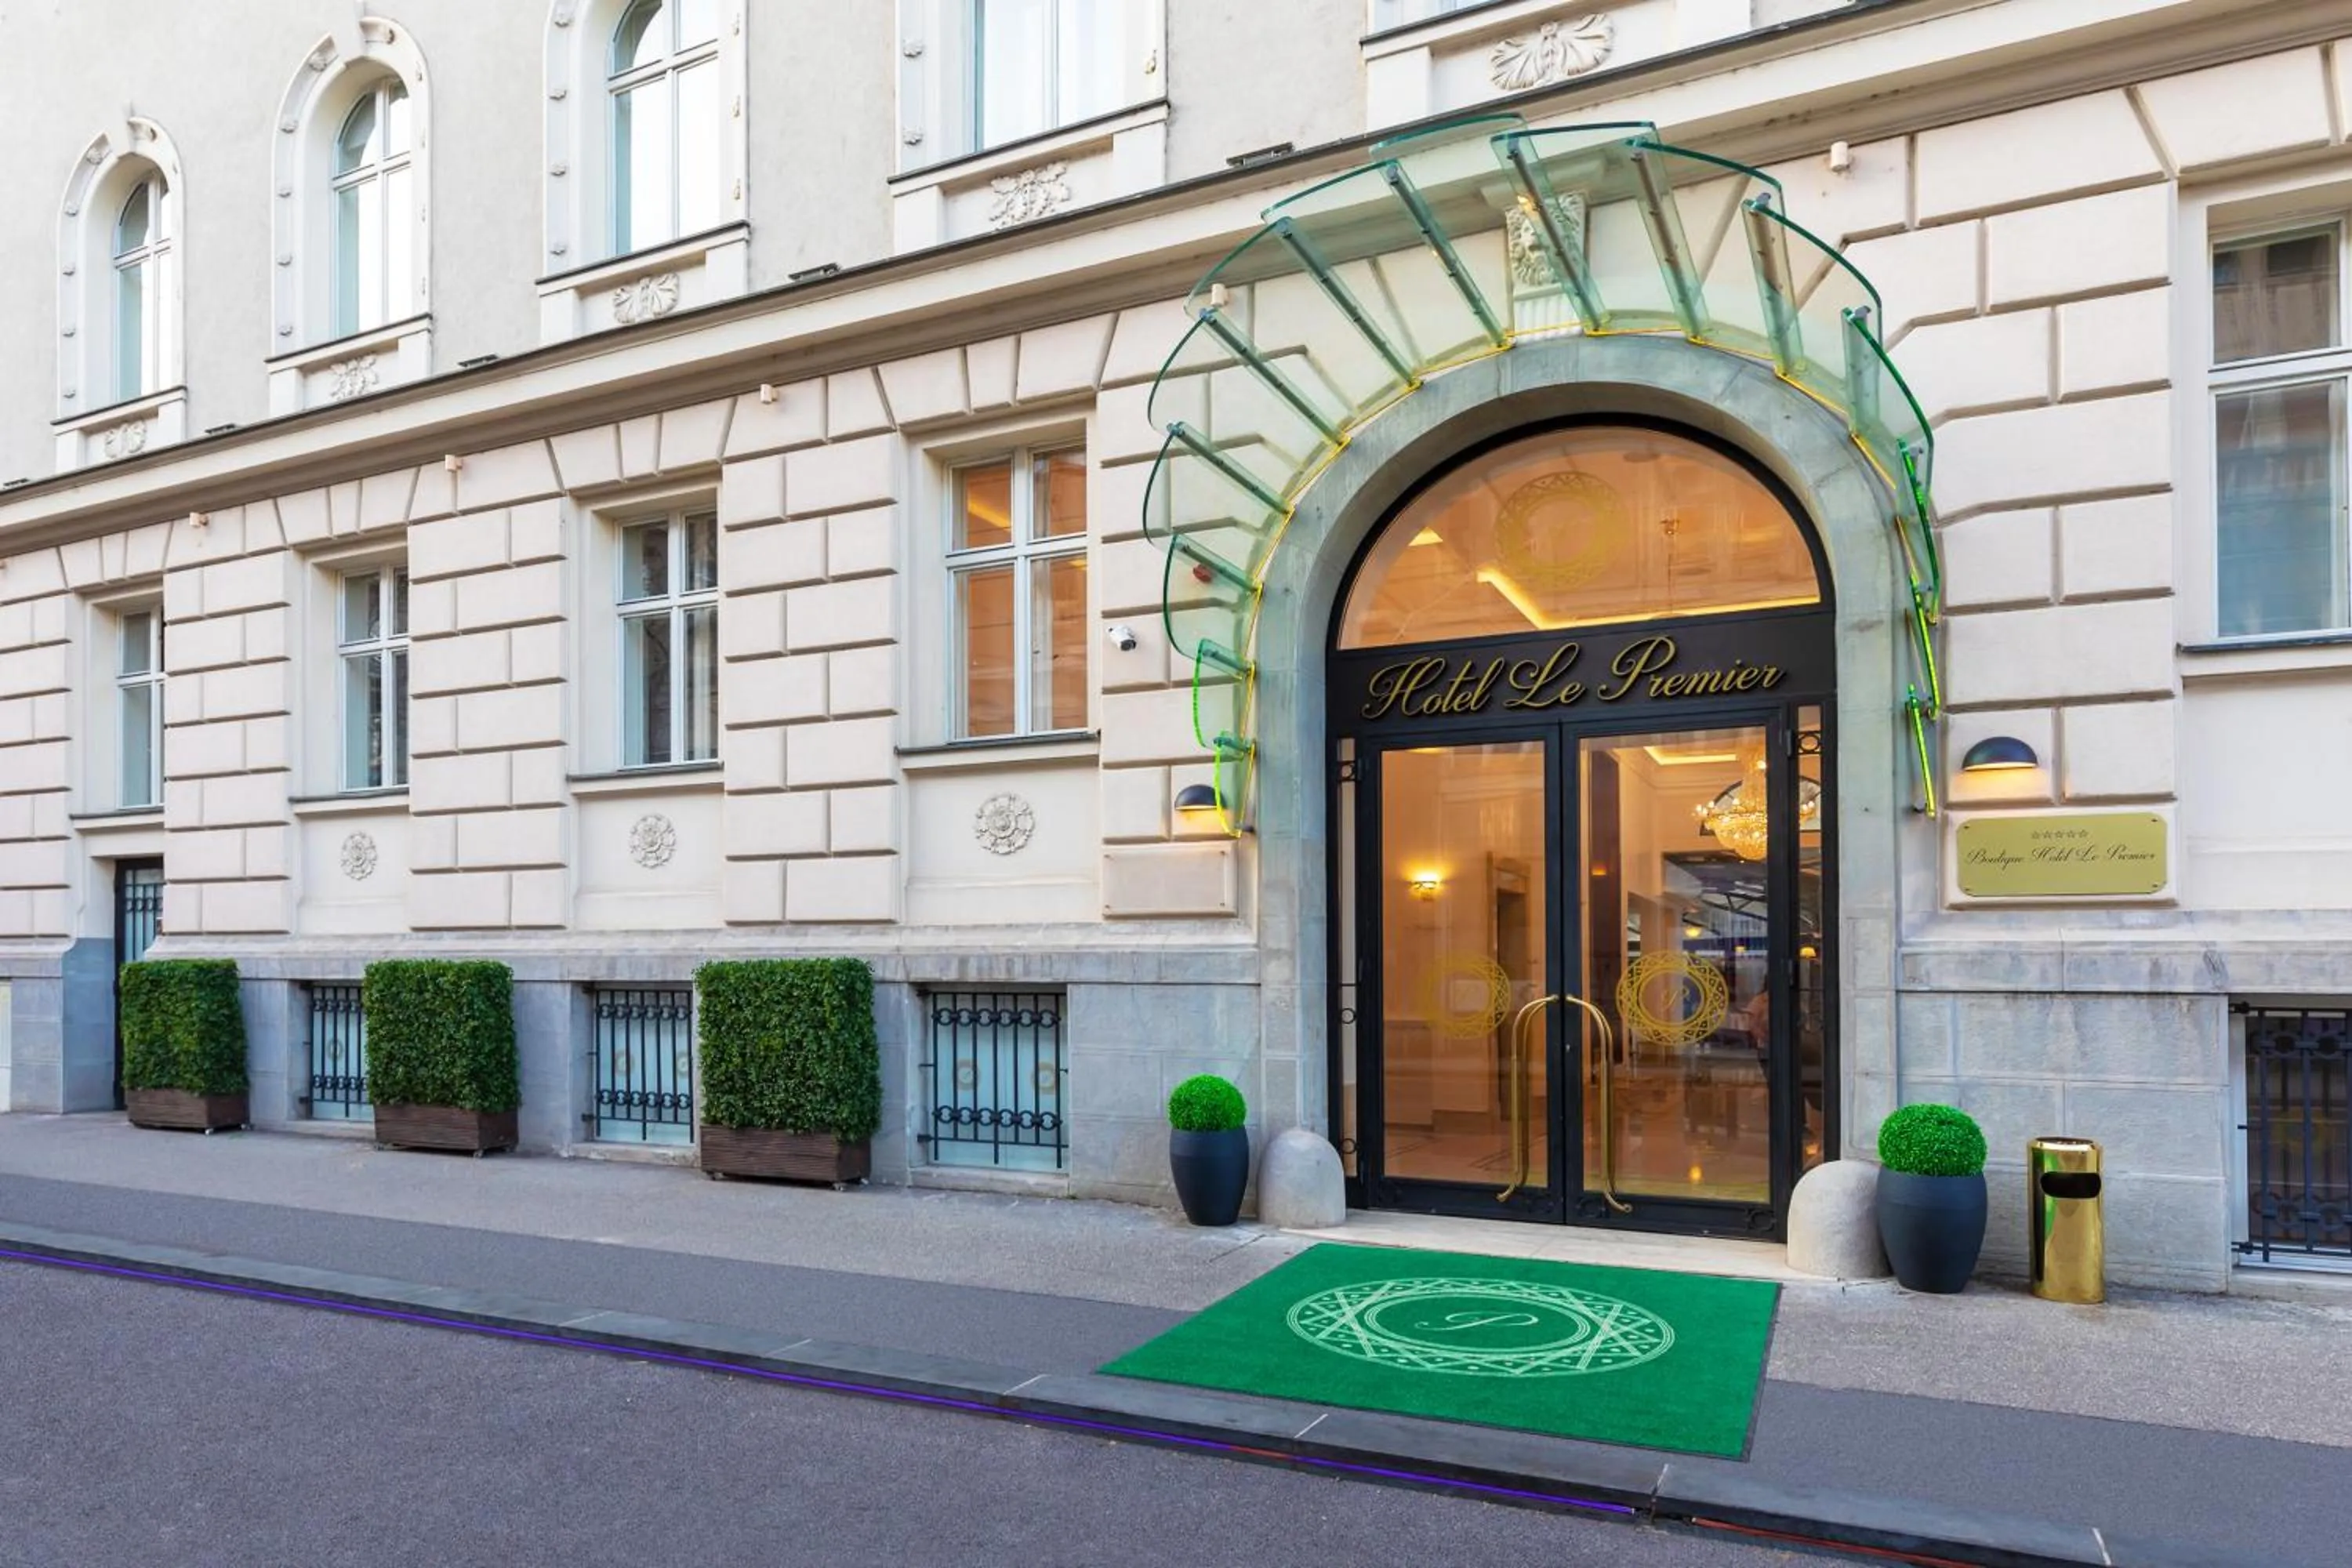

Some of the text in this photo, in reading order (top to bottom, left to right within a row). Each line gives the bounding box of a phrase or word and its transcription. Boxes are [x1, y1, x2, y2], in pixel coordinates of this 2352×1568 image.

[1361, 635, 1787, 720] Hotel Le Premier
[1966, 844, 2155, 870] Boutique Hotel Le Premier
